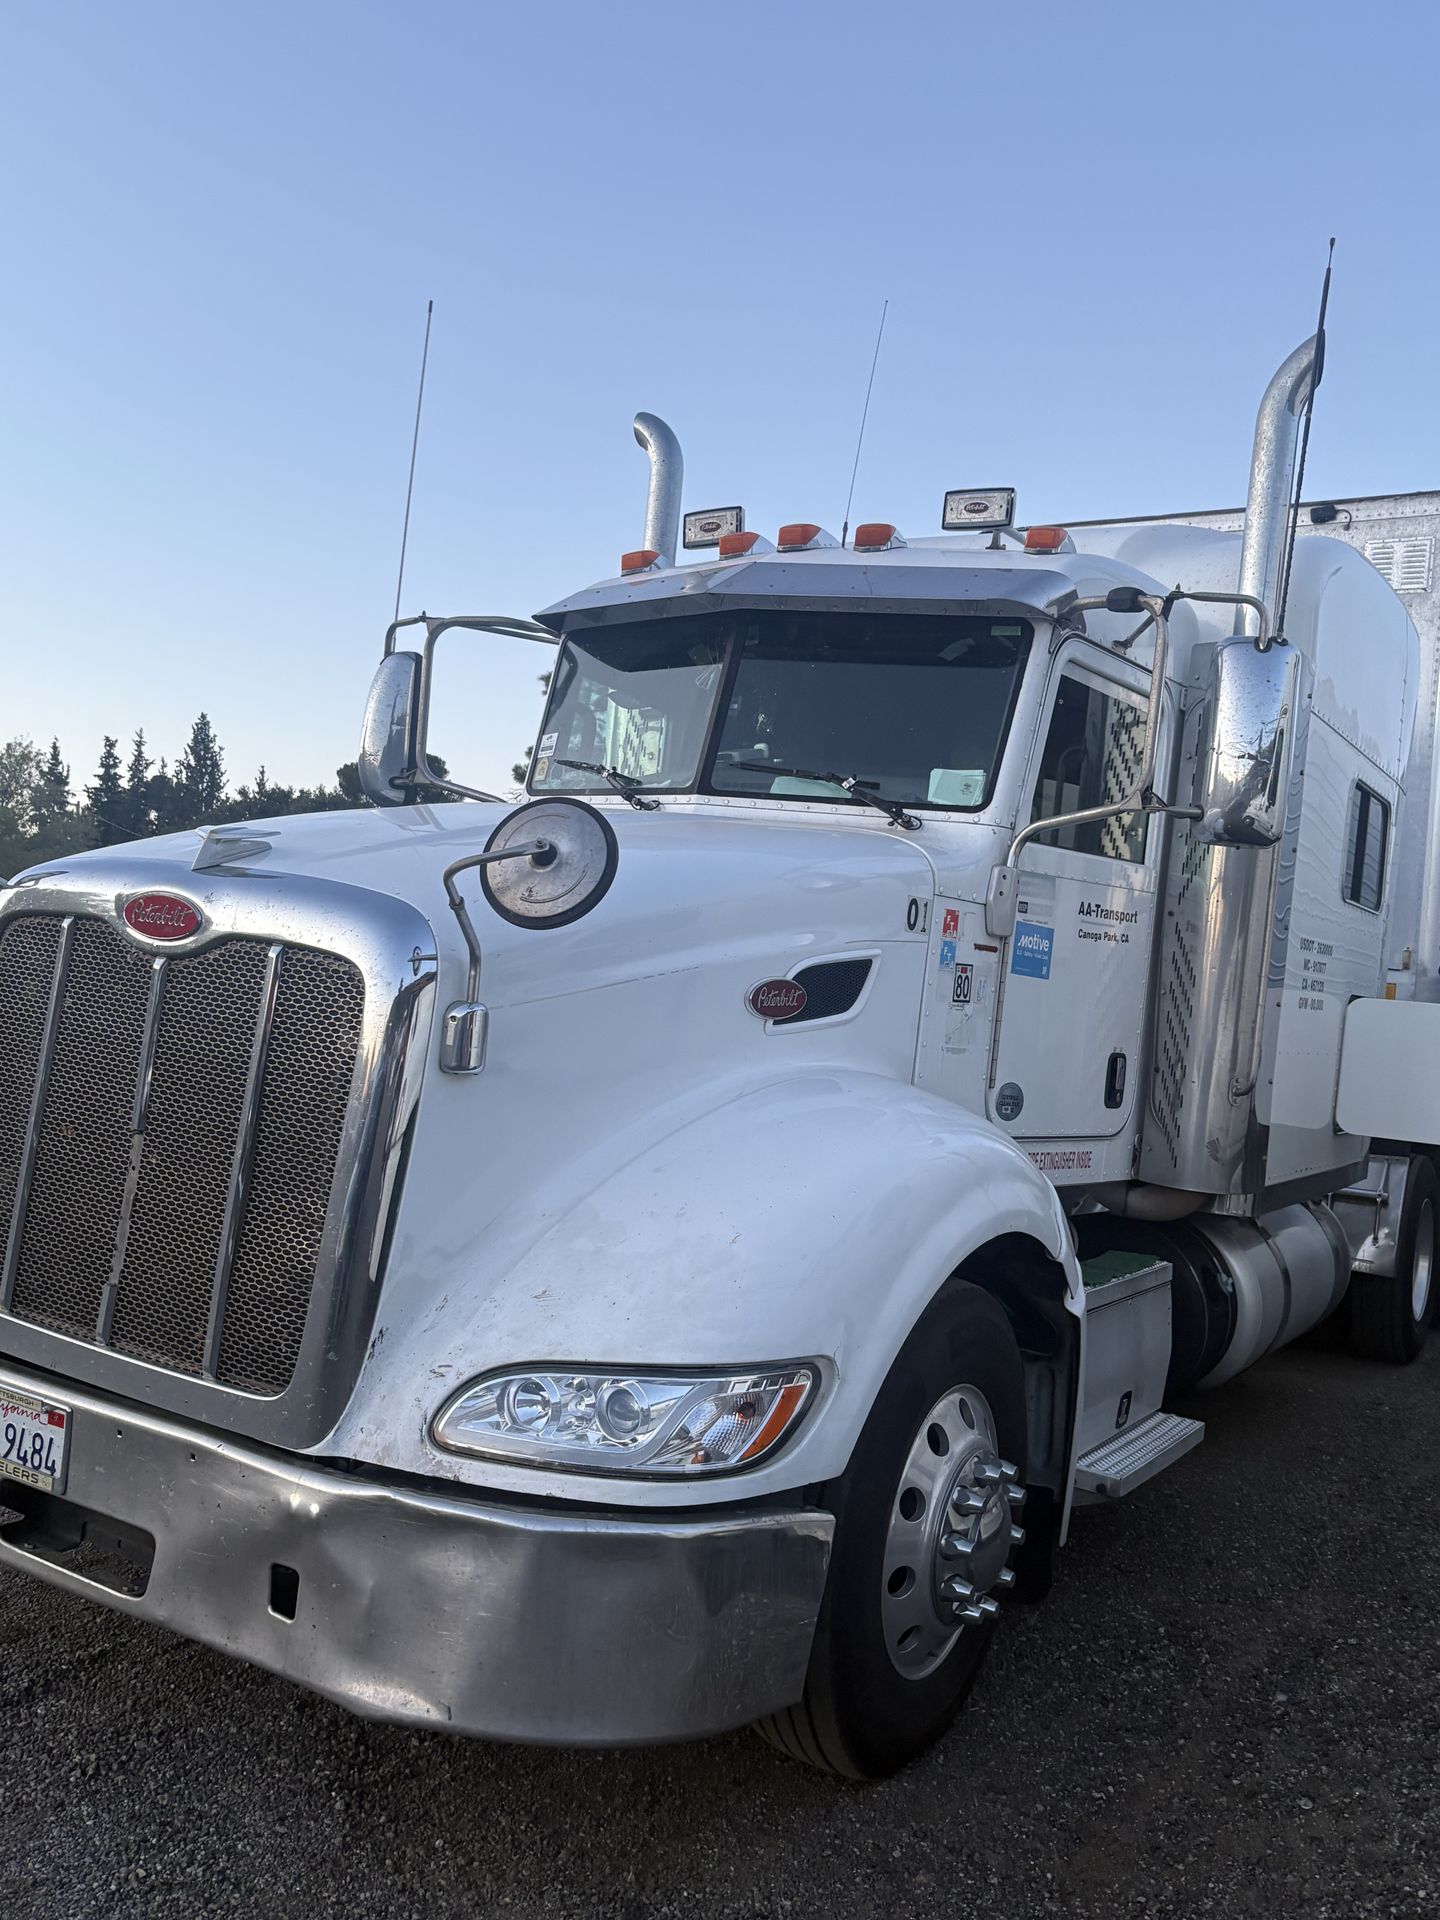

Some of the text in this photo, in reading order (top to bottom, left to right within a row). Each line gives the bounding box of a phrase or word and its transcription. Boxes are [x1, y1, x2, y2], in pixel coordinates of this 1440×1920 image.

[130, 899, 194, 927] Peterbilt
[907, 898, 928, 933] 01
[1078, 901, 1138, 924] AA-Transport
[1017, 933, 1050, 952] Motive
[1077, 929, 1102, 943] Canoga
[1120, 934, 1129, 944] CA
[758, 986, 803, 1009] Peterbilt
[955, 974, 970, 999] 80
[2, 1423, 56, 1476] 9484
